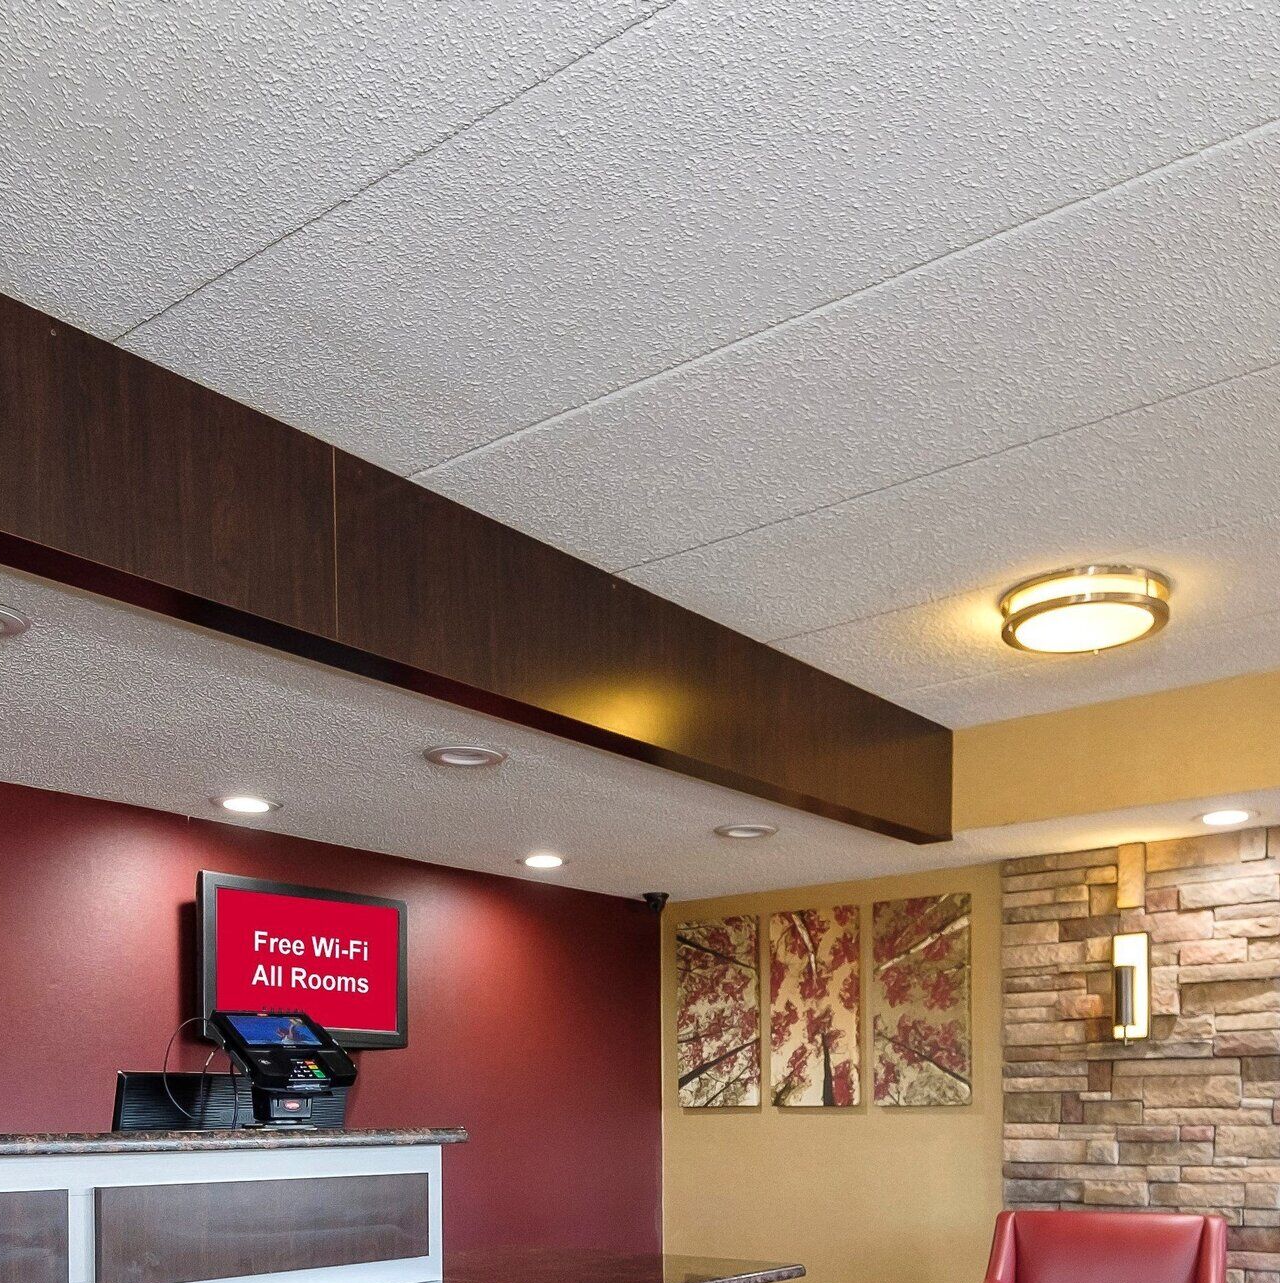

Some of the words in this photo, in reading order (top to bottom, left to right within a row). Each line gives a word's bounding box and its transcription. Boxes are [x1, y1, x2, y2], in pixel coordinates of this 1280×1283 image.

[253, 930, 305, 956] Free
[311, 935, 369, 962] Wi-Fi
[251, 964, 283, 987] All
[291, 966, 369, 994] Rooms
